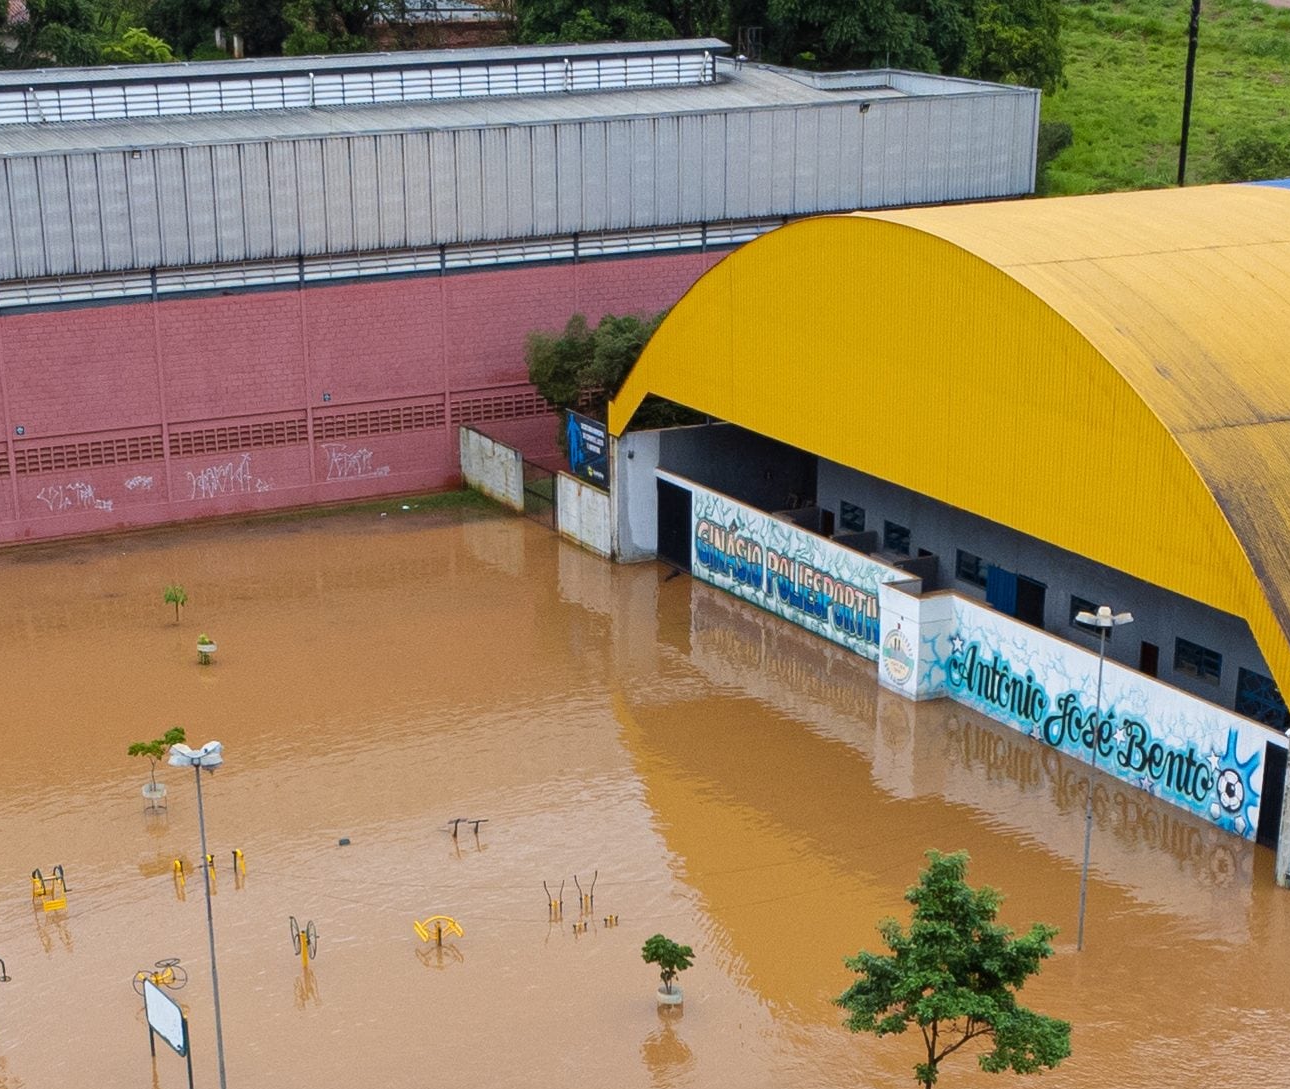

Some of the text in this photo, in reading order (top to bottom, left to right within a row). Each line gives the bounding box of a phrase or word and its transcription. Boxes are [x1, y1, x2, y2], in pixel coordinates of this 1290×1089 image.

[695, 517, 764, 590] GINÁSIO
[948, 644, 1214, 802] Antônio José Bento
